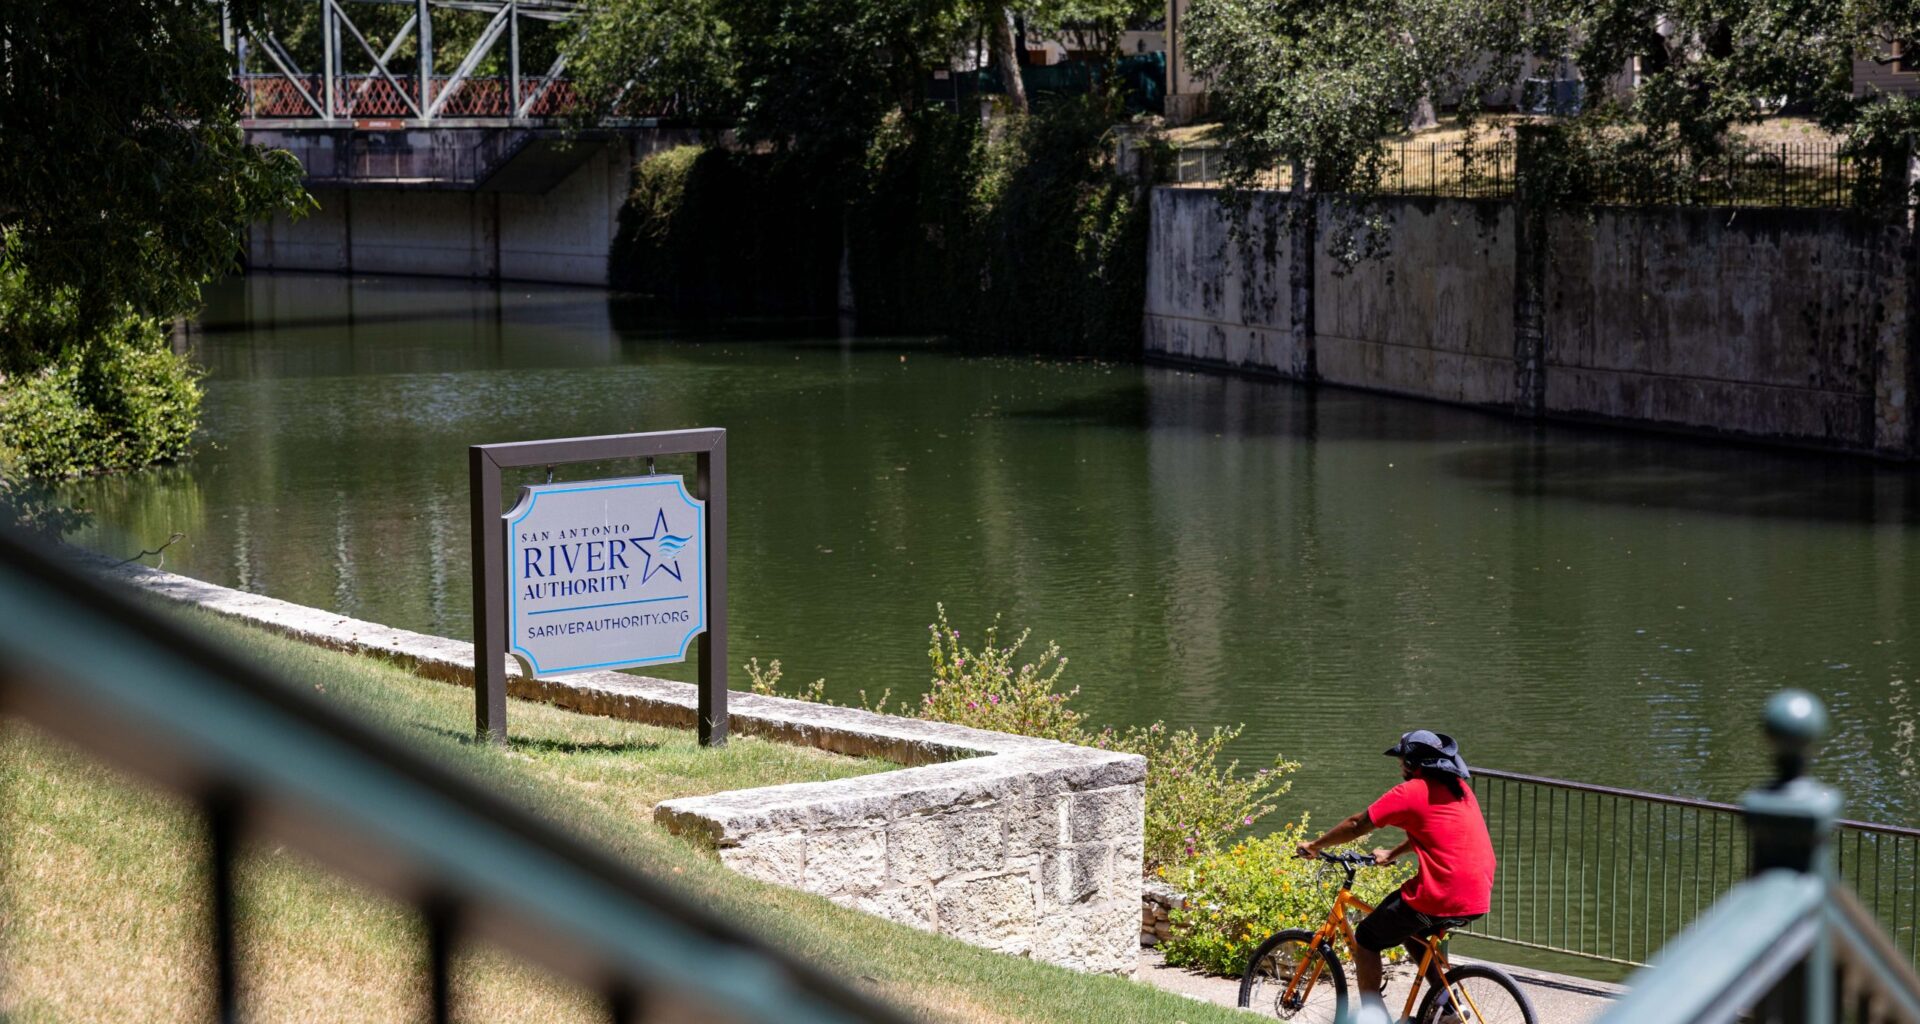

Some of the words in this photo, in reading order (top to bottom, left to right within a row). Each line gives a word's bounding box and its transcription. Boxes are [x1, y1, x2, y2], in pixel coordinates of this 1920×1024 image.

[521, 532, 550, 543] SAN
[560, 524, 631, 540] ANTONIO
[523, 539, 630, 579] RIVER
[523, 574, 630, 601] AUTHORITY
[528, 610, 689, 639] SARIVERAUTHORITY.ORG
